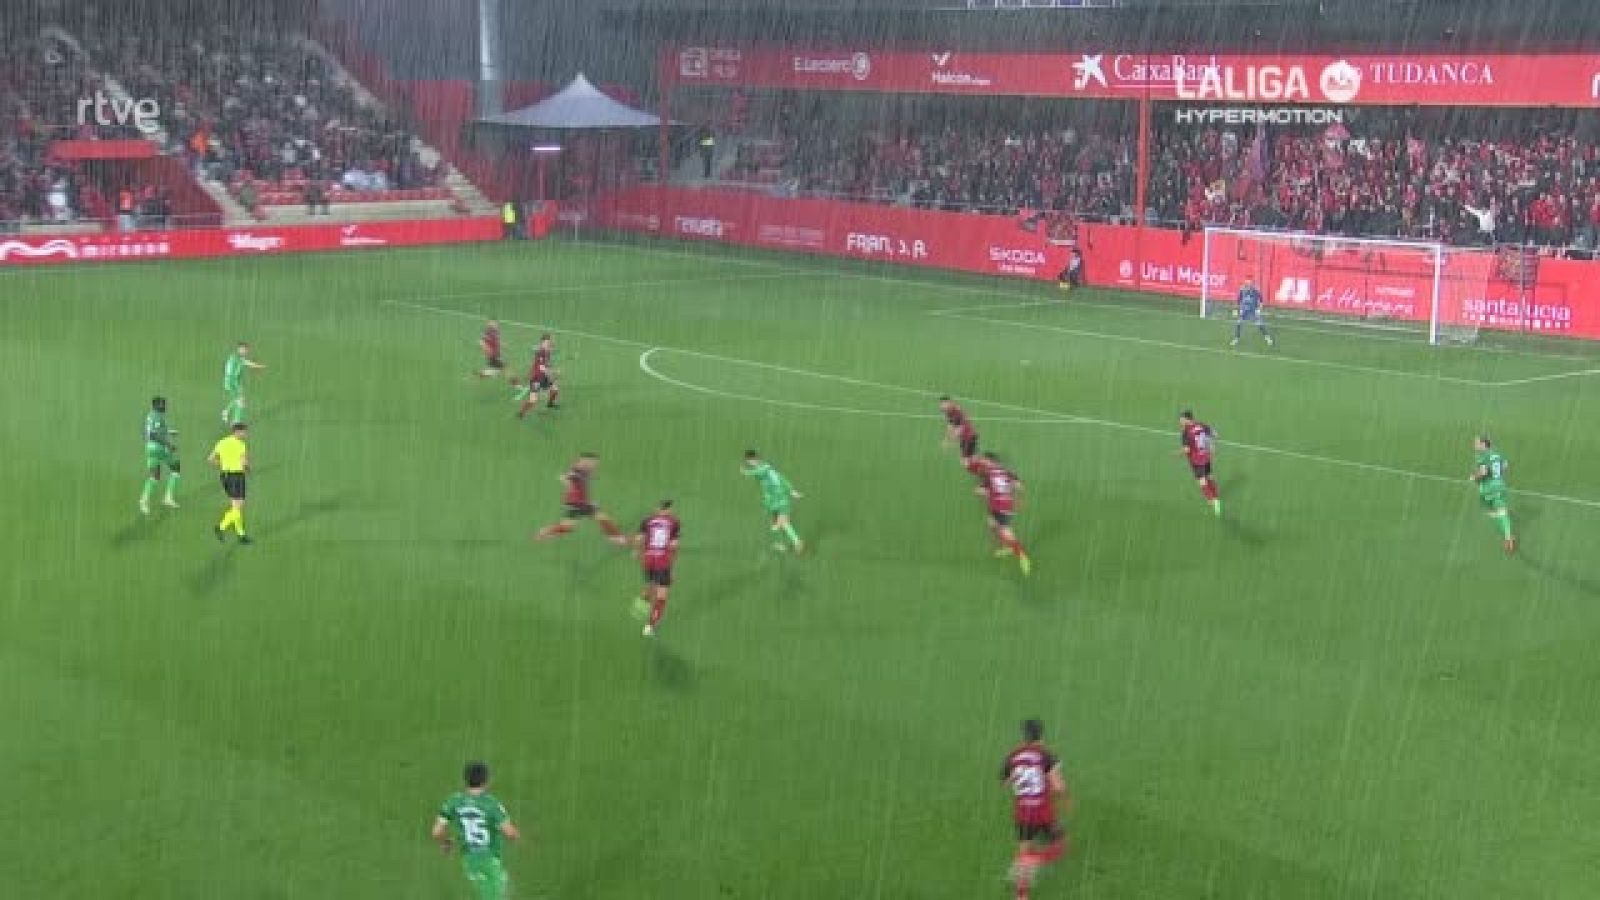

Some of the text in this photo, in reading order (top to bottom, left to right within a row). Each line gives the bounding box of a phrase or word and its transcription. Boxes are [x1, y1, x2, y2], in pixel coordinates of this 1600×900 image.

[1370, 61, 1495, 85] TUDANCA
[1141, 261, 1173, 283] Ural
[1013, 764, 1046, 796] 23
[460, 816, 491, 846] 15
